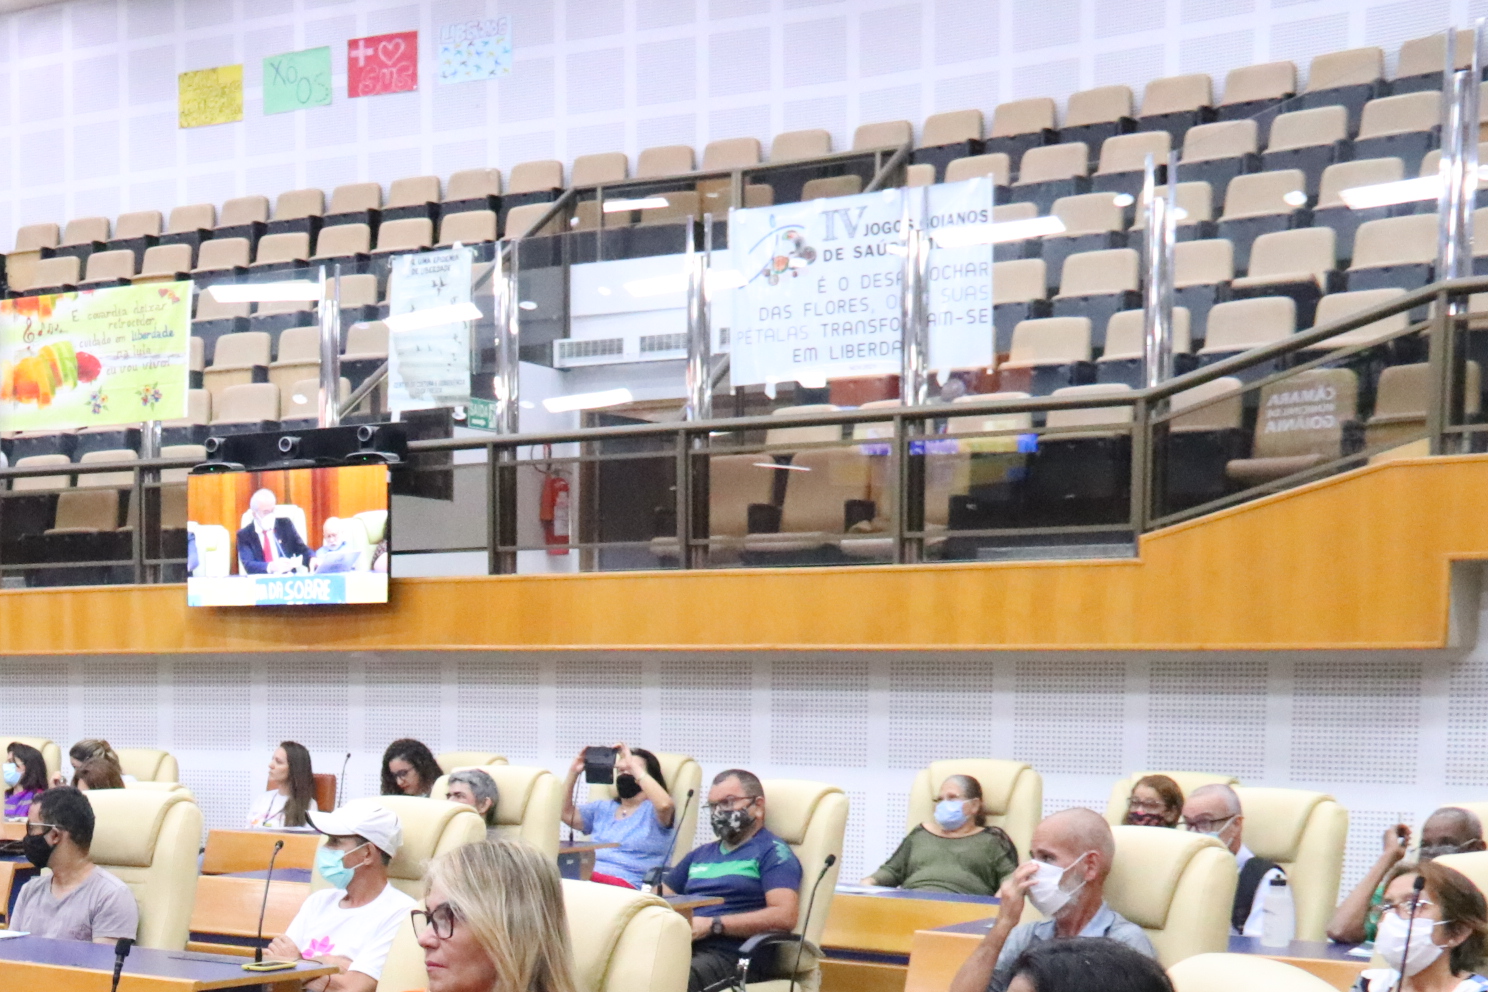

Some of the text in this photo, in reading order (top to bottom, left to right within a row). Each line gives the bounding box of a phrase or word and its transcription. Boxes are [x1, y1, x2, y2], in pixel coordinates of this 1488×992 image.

[820, 206, 867, 242] IV
[921, 209, 989, 231] OIANOS
[823, 239, 906, 262] DE SAÚ
[817, 261, 989, 293] É O DESAOCHAR
[759, 304, 792, 321] DAS
[941, 285, 989, 302] SUAS
[821, 308, 989, 338] TRANSFOAM-SE
[793, 339, 905, 363] EM LIBERDA
[284, 578, 331, 600] SOBRE
